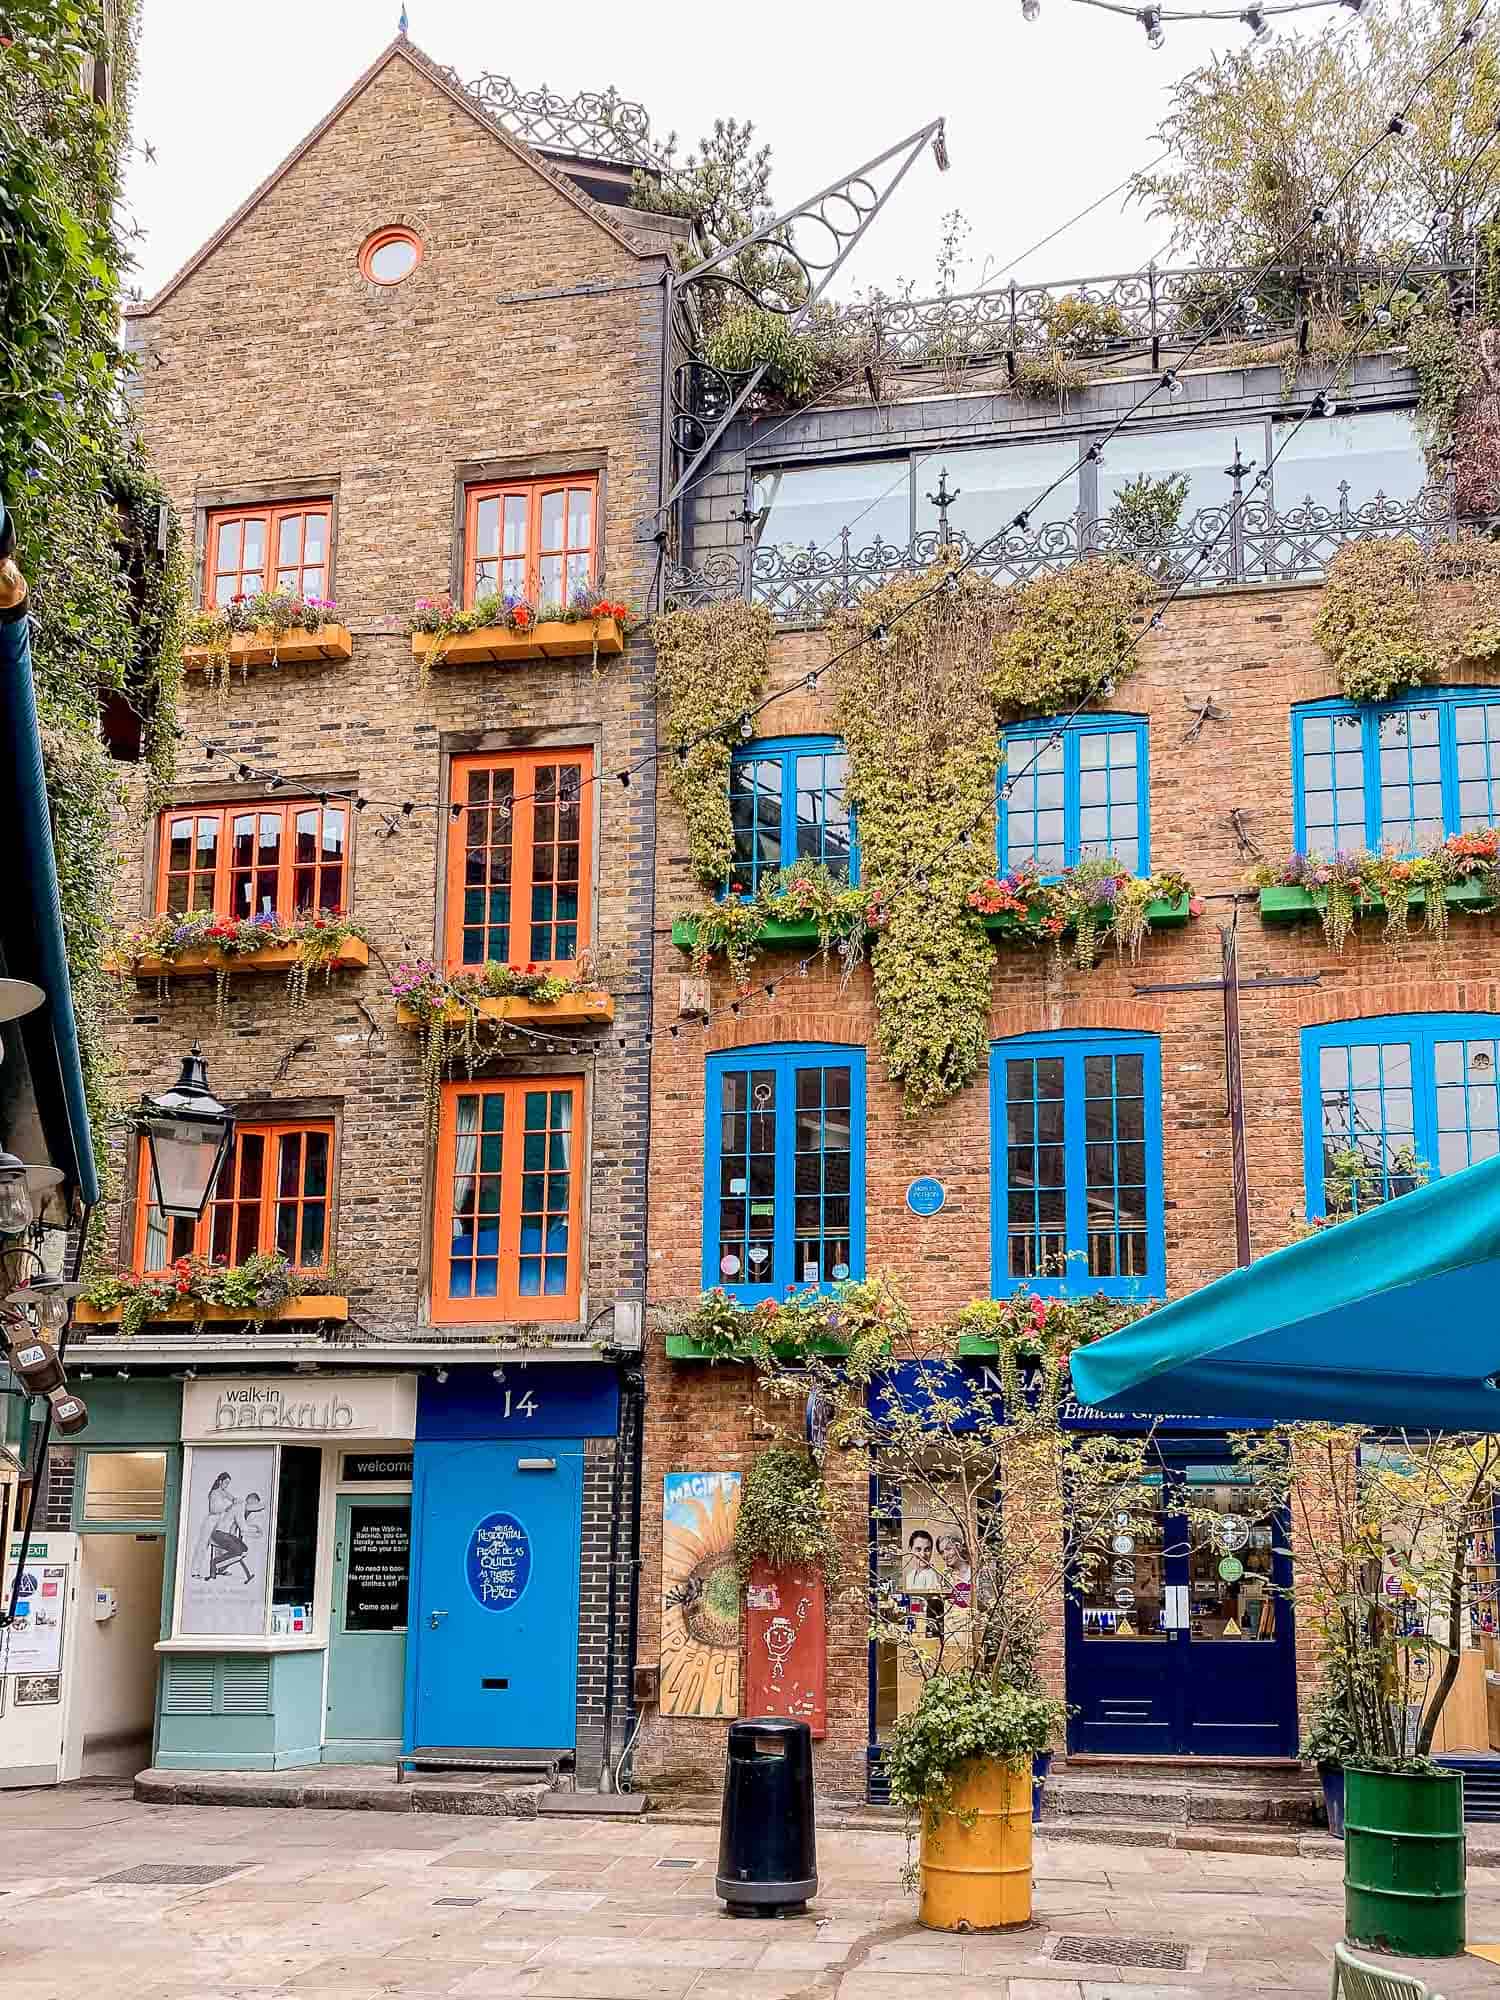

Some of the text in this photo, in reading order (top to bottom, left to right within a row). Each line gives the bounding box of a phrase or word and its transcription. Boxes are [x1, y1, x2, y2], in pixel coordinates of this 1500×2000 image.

[226, 1387, 280, 1402] walk-in
[216, 1394, 353, 1428] backrub
[504, 1390, 539, 1418] 14
[28, 1546, 47, 1556] EXIT
[514, 1547, 525, 1557] AS
[480, 1555, 517, 1569] QUIET
[480, 1584, 518, 1601] PEACE
[359, 1603, 379, 1611] Come
